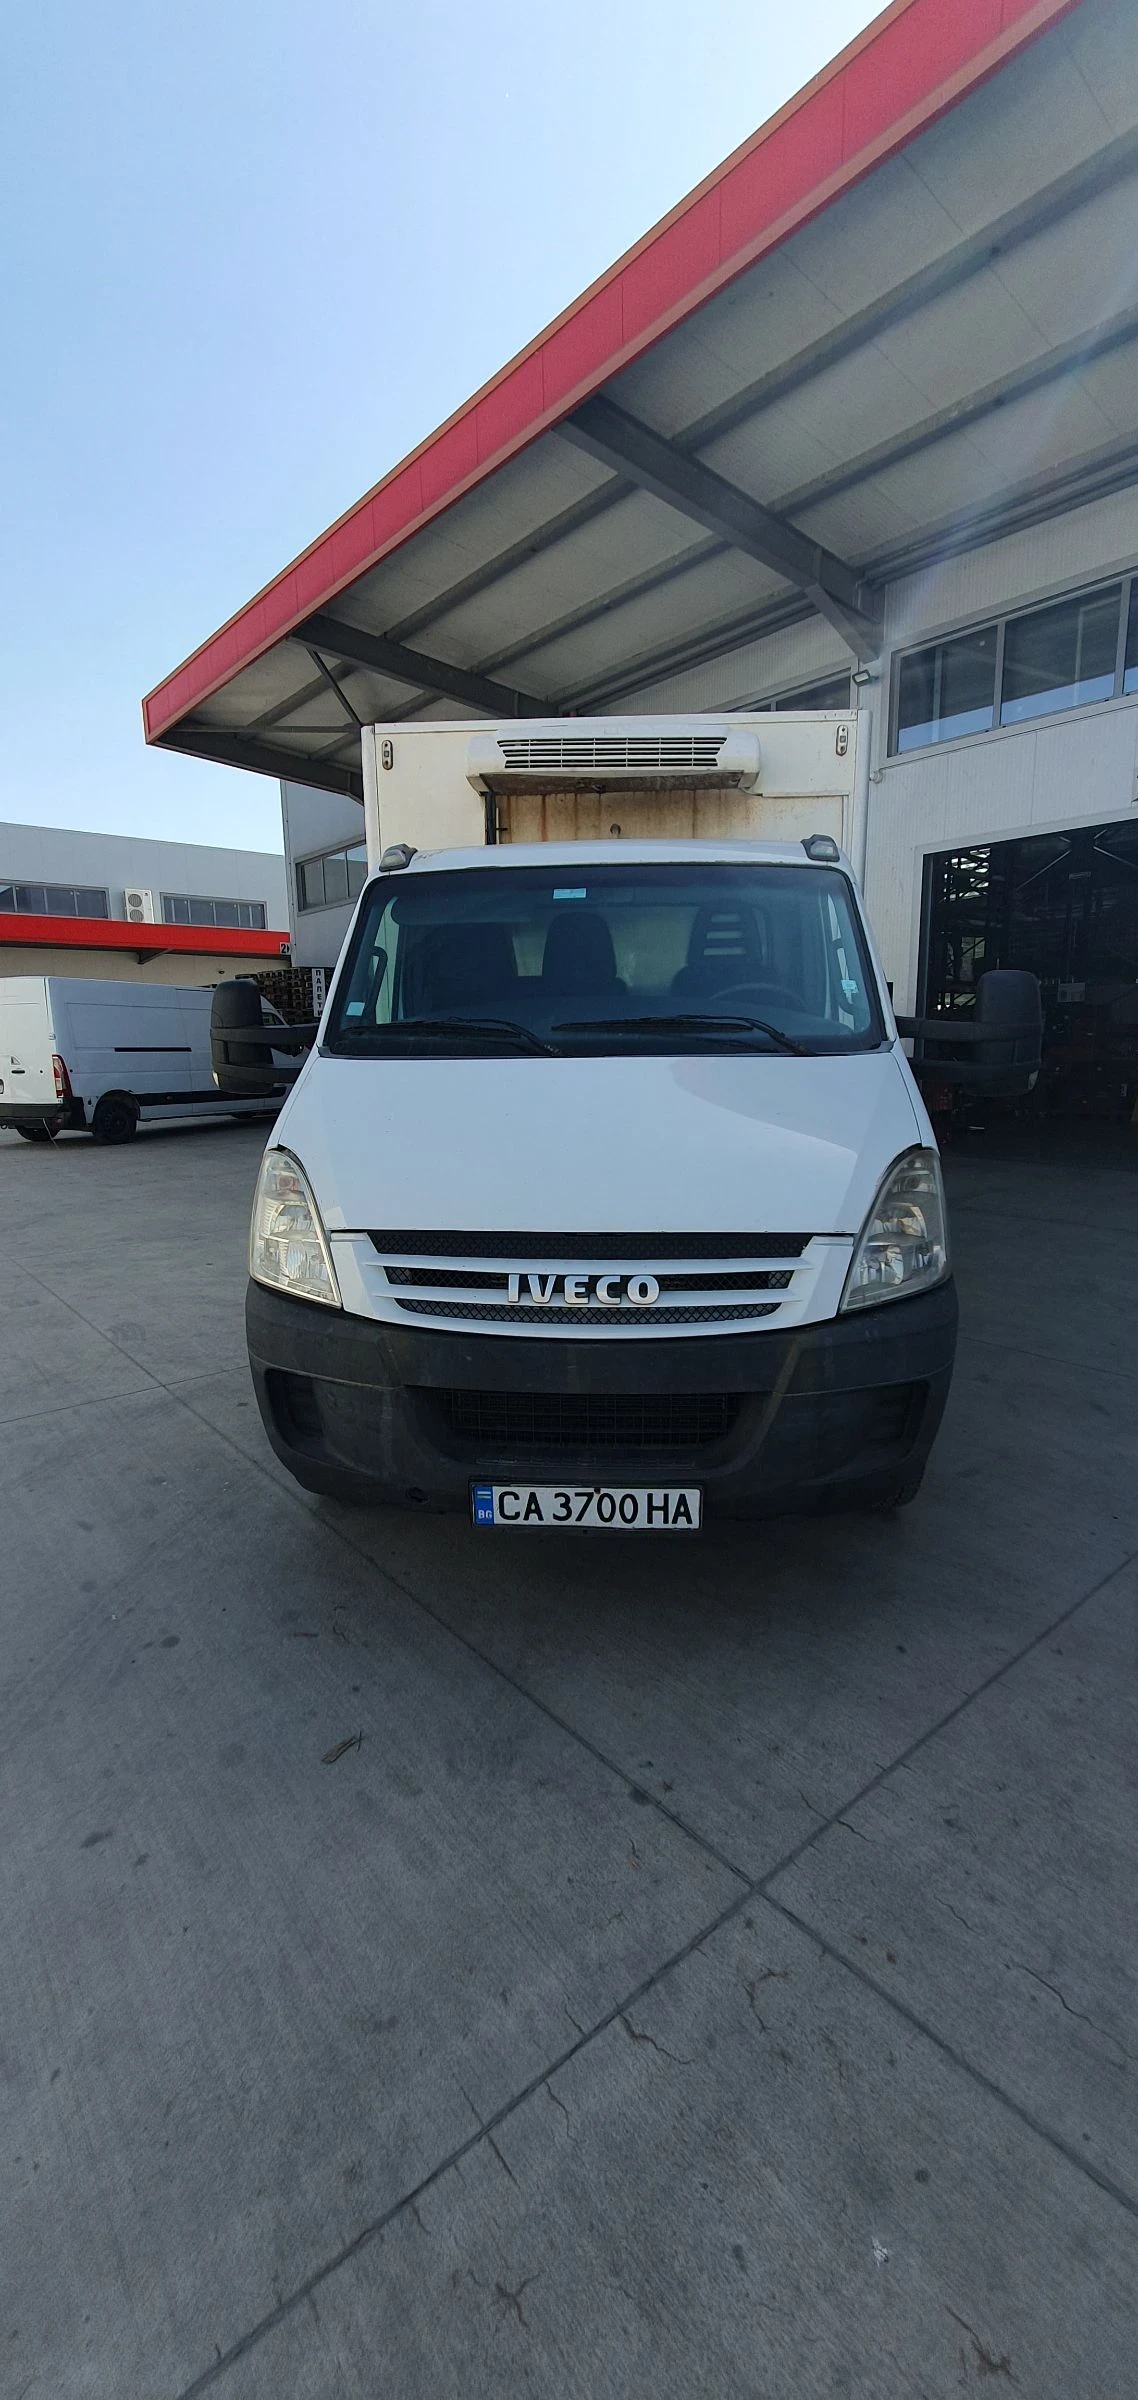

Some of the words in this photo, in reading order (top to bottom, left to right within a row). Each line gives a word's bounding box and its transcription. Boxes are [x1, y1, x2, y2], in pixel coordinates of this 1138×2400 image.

[508, 1274, 660, 1305] IVECO
[477, 1509, 492, 1519] BG
[498, 1491, 544, 1521] CA
[552, 1492, 639, 1523] 3700
[646, 1492, 693, 1524] HA
